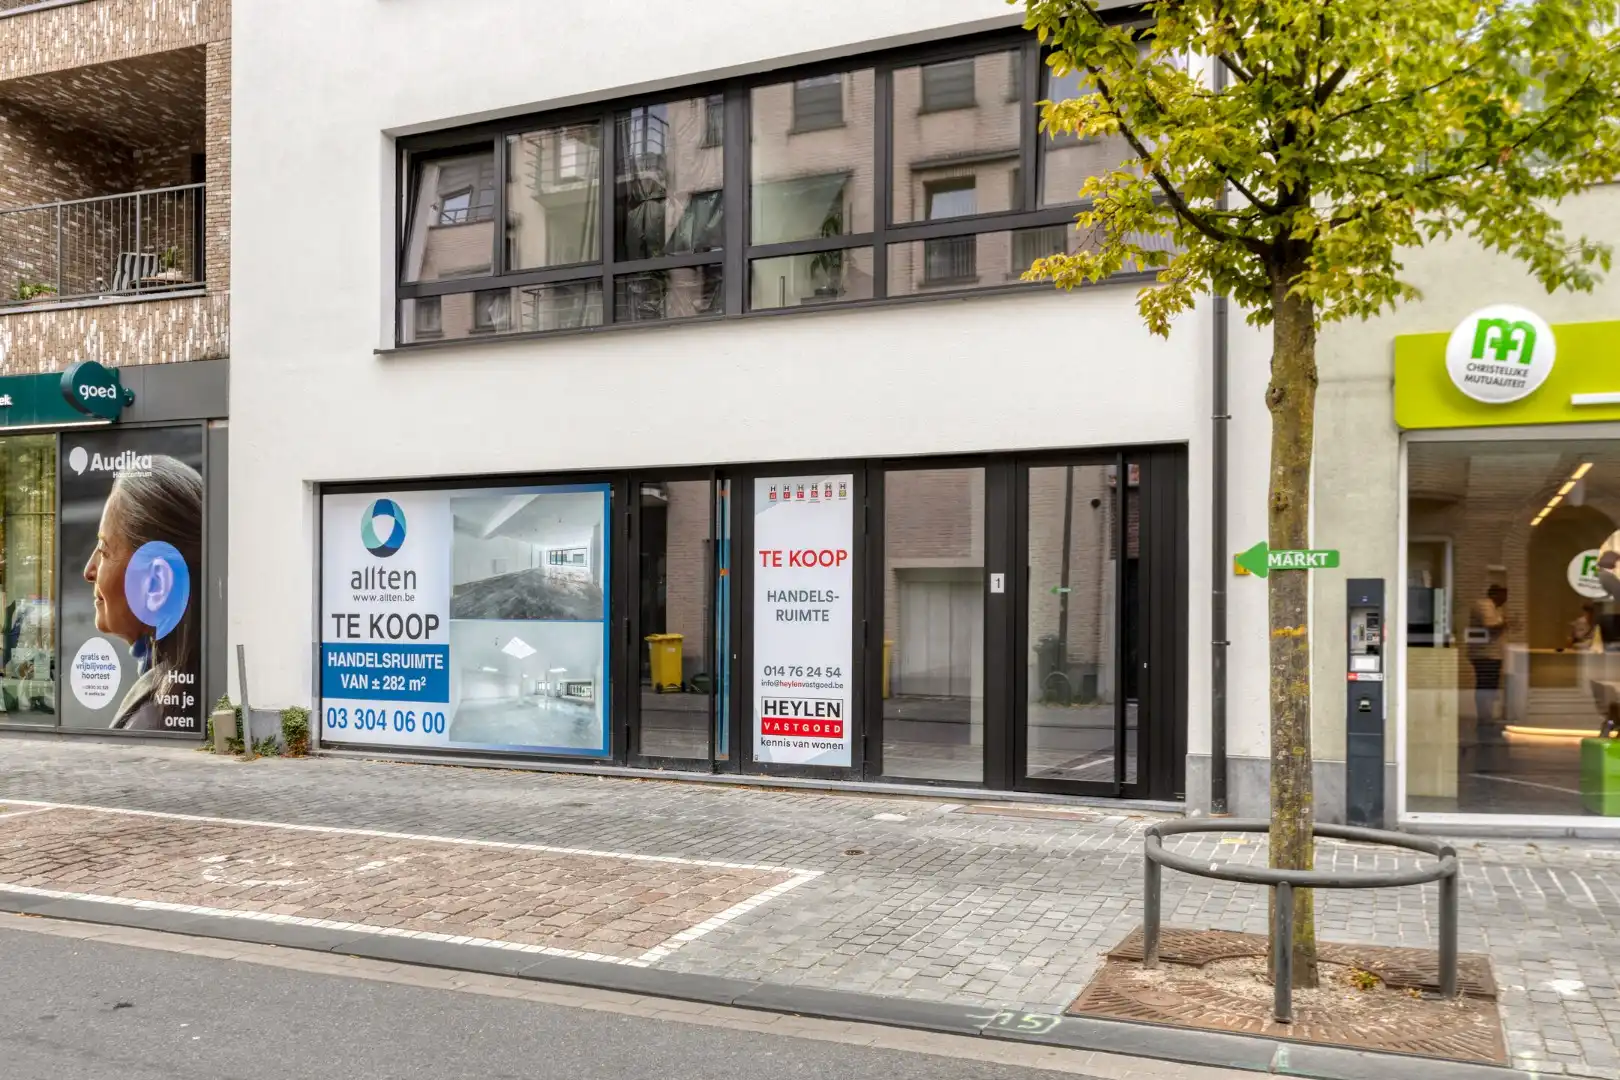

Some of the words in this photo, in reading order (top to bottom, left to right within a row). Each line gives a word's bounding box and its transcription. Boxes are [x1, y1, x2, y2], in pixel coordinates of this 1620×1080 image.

[1466, 363, 1529, 377] CHRISTELIJKE
[1464, 374, 1526, 388] MUTUALITEIT
[79, 384, 117, 400] goed
[90, 450, 152, 471] Audika
[759, 550, 782, 567] TE
[790, 550, 848, 567] KOOP
[1268, 552, 1328, 567] MARKT
[350, 565, 417, 590] allten
[995, 577, 1000, 589] 1
[353, 593, 415, 602] www.allten.be
[767, 590, 840, 603] HANDELS-
[776, 609, 829, 622] RUIMTE
[331, 613, 361, 639] TE
[369, 613, 440, 639] KOOP
[80, 653, 99, 662] gratis
[328, 652, 444, 670] HANDELSRUIMTE
[76, 662, 116, 671] vrijblijvende
[764, 665, 785, 676] 014
[788, 666, 803, 677] 76
[806, 667, 822, 677] 24
[825, 667, 841, 678] 54
[81, 672, 110, 680] hoortest
[168, 670, 194, 685] Hou
[341, 674, 368, 690] VAN
[372, 678, 380, 690] ±
[383, 675, 405, 690] 282
[761, 680, 843, 689] info@heylenvastgoed.be
[156, 695, 179, 706] van
[182, 692, 194, 708] je
[764, 700, 841, 718] HEYLEN
[165, 716, 194, 728] oren
[327, 707, 348, 729] 03
[354, 708, 387, 731] 304
[393, 710, 416, 732] 06
[422, 711, 445, 734] 00
[764, 722, 841, 733] VASTGOED
[761, 738, 791, 748] kennis
[811, 742, 844, 750] wonen
